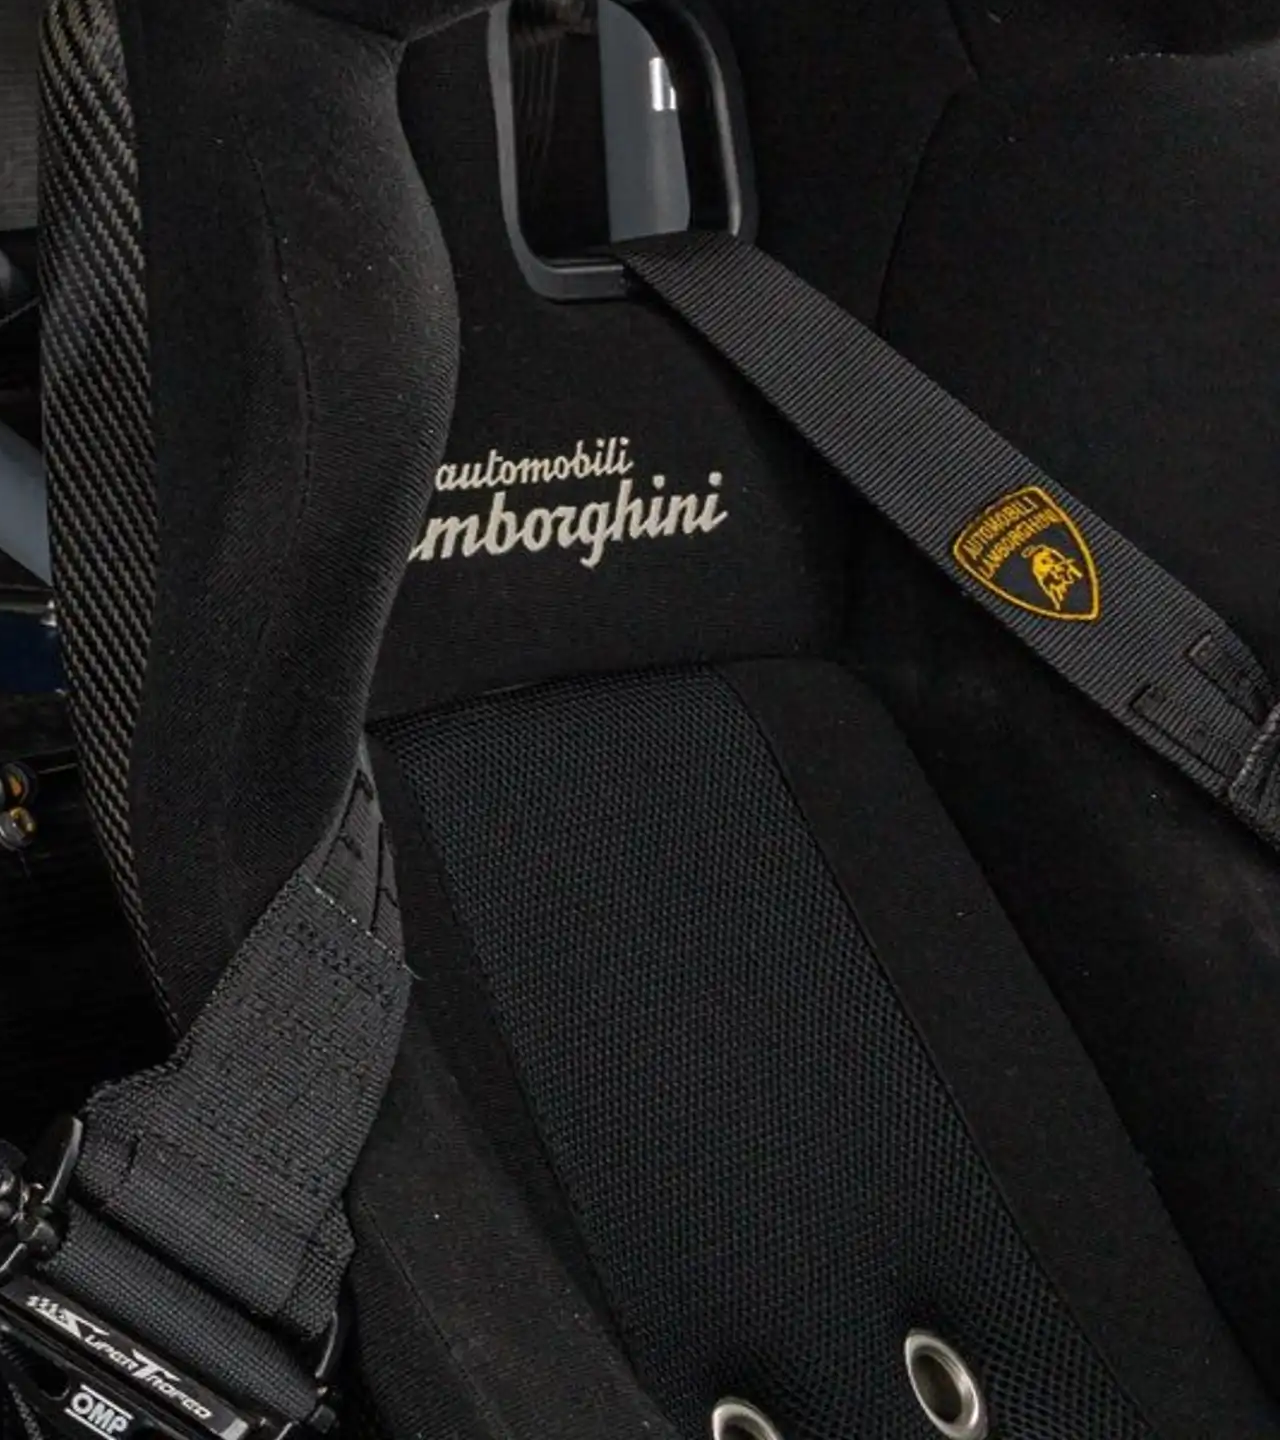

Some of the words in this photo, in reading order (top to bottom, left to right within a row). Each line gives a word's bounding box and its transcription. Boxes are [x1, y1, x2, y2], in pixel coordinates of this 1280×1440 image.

[435, 436, 634, 491] automobili
[407, 471, 729, 568] mborghini
[961, 495, 1039, 560] AUTOMOBILI
[70, 1391, 130, 1435] OMP
